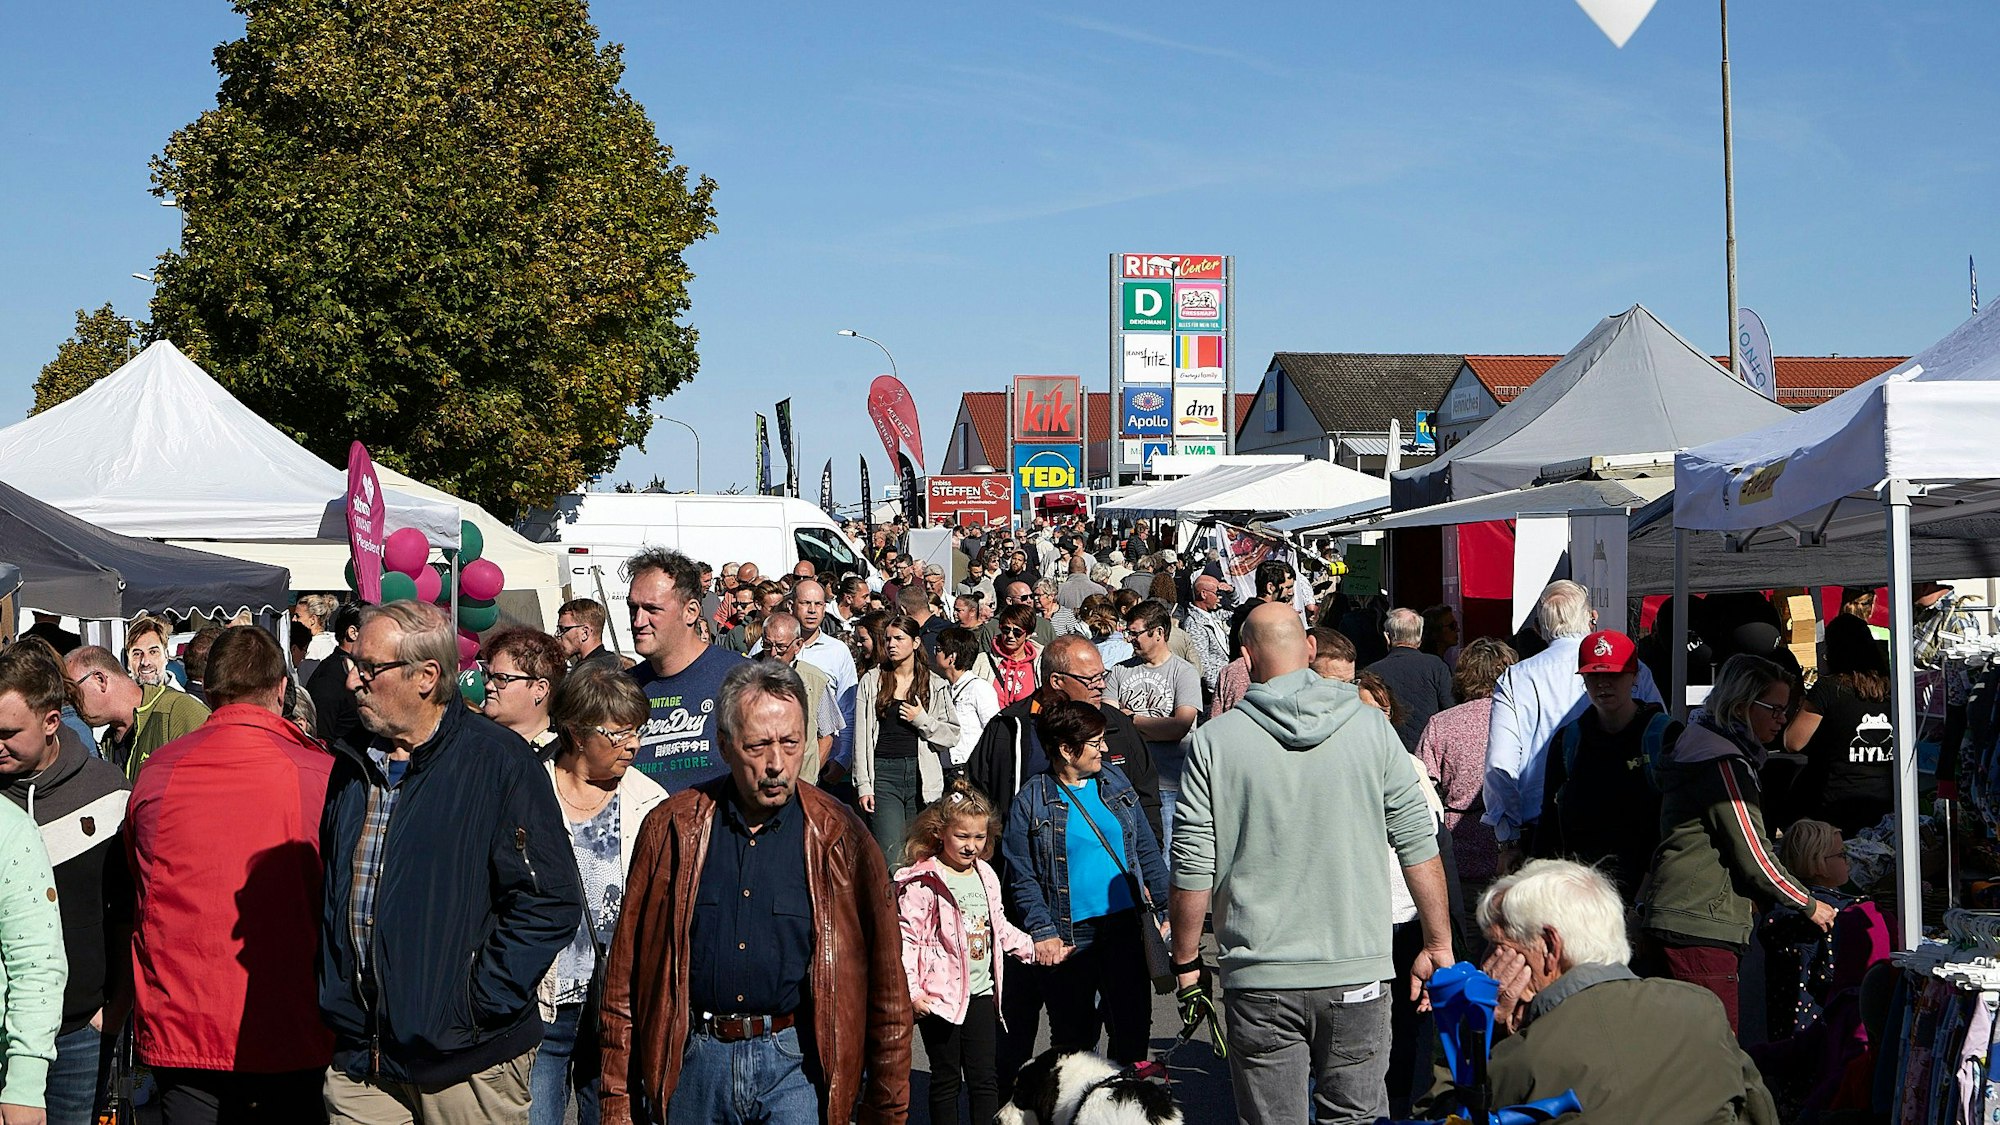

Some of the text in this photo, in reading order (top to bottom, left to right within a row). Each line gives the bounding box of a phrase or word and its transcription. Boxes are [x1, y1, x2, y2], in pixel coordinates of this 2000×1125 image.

[1180, 257, 1220, 276] Center
[1135, 288, 1163, 317] D
[1186, 400, 1214, 416] dm
[1127, 414, 1169, 429] Apollo
[1185, 445, 1206, 455] LVM
[1018, 466, 1076, 488] TEDi
[931, 486, 981, 497] STEFFEN
[650, 696, 682, 708] INTAGE
[1120, 689, 1163, 711] Köln
[670, 756, 713, 770] STORE.
